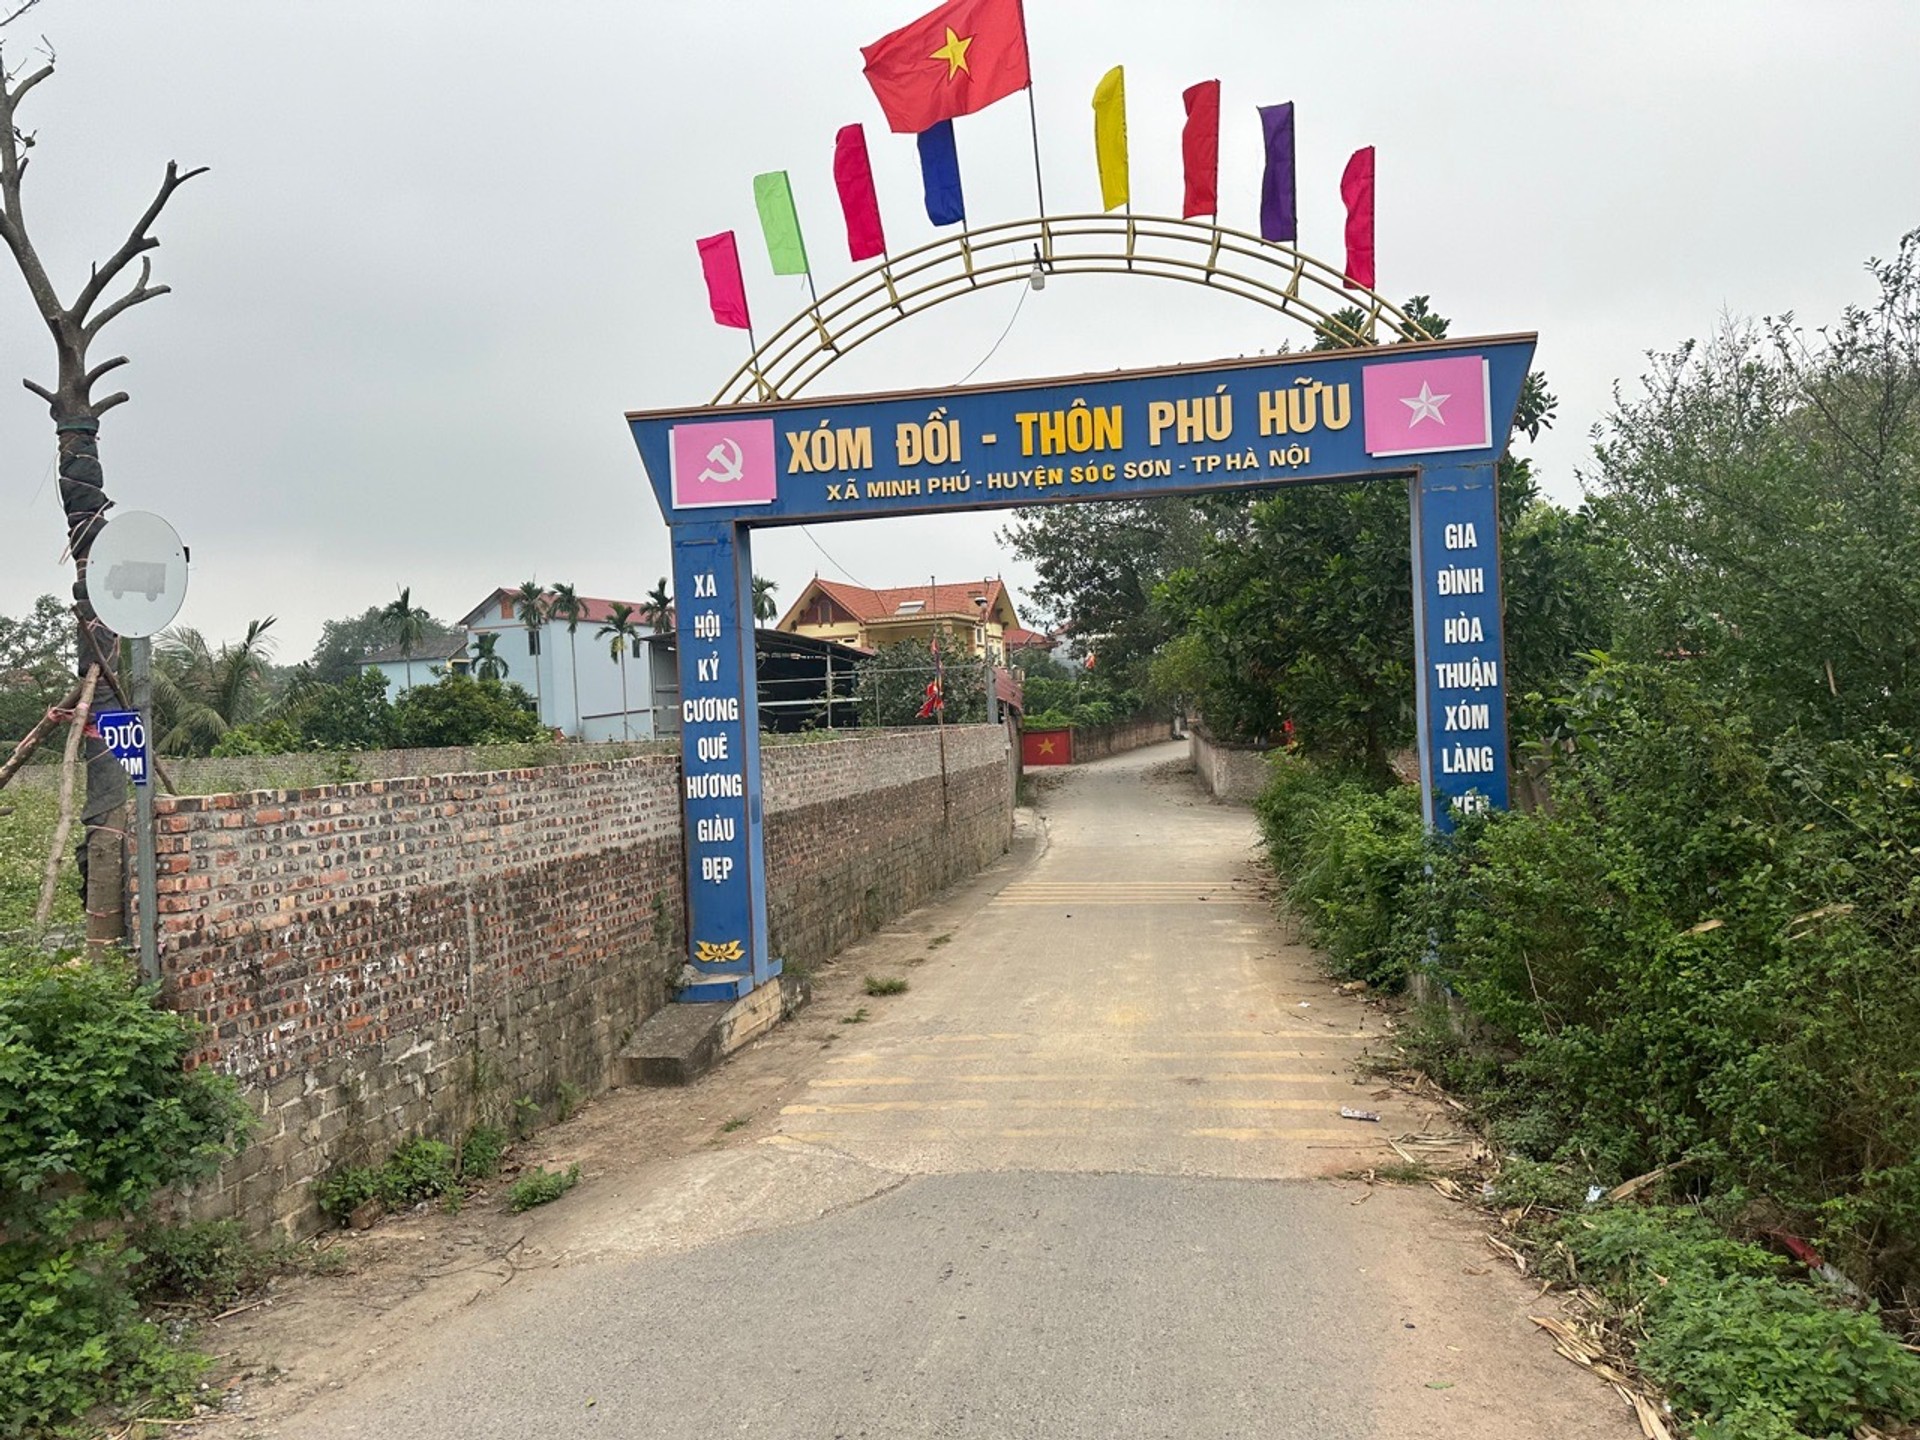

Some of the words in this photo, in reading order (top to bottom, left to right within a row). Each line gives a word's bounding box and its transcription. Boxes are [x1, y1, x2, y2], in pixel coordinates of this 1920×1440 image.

[785, 419, 873, 474] XÓM
[896, 407, 962, 466] ĐỒI
[1015, 398, 1123, 456] THÔN
[1149, 384, 1233, 447] PHÚ
[1259, 376, 1351, 437] HỮU
[826, 478, 860, 501] XÃ
[867, 479, 921, 498] MINH
[928, 470, 971, 494] PHÚ
[988, 465, 1064, 490] HUYỆN
[1070, 459, 1116, 484] SÓC
[1123, 459, 1172, 480] SƠN
[1191, 455, 1222, 473] TP
[1226, 447, 1260, 470] HÀ
[1269, 443, 1311, 469] NỘI
[1444, 522, 1478, 550] GIA
[1437, 564, 1484, 595] ĐÌNH
[694, 609, 722, 642] HỘI
[1444, 611, 1484, 644] HÒA
[698, 651, 720, 682] KỶ
[1435, 656, 1498, 691] THUẬN
[683, 697, 739, 723] CƯƠNG
[1444, 699, 1489, 731] XÓM
[697, 732, 729, 763] QUÊ
[1442, 742, 1494, 774] LÀNG
[686, 773, 743, 799] HƯƠNG
[697, 814, 735, 842] GIÀU
[702, 856, 734, 884] ĐẸP
